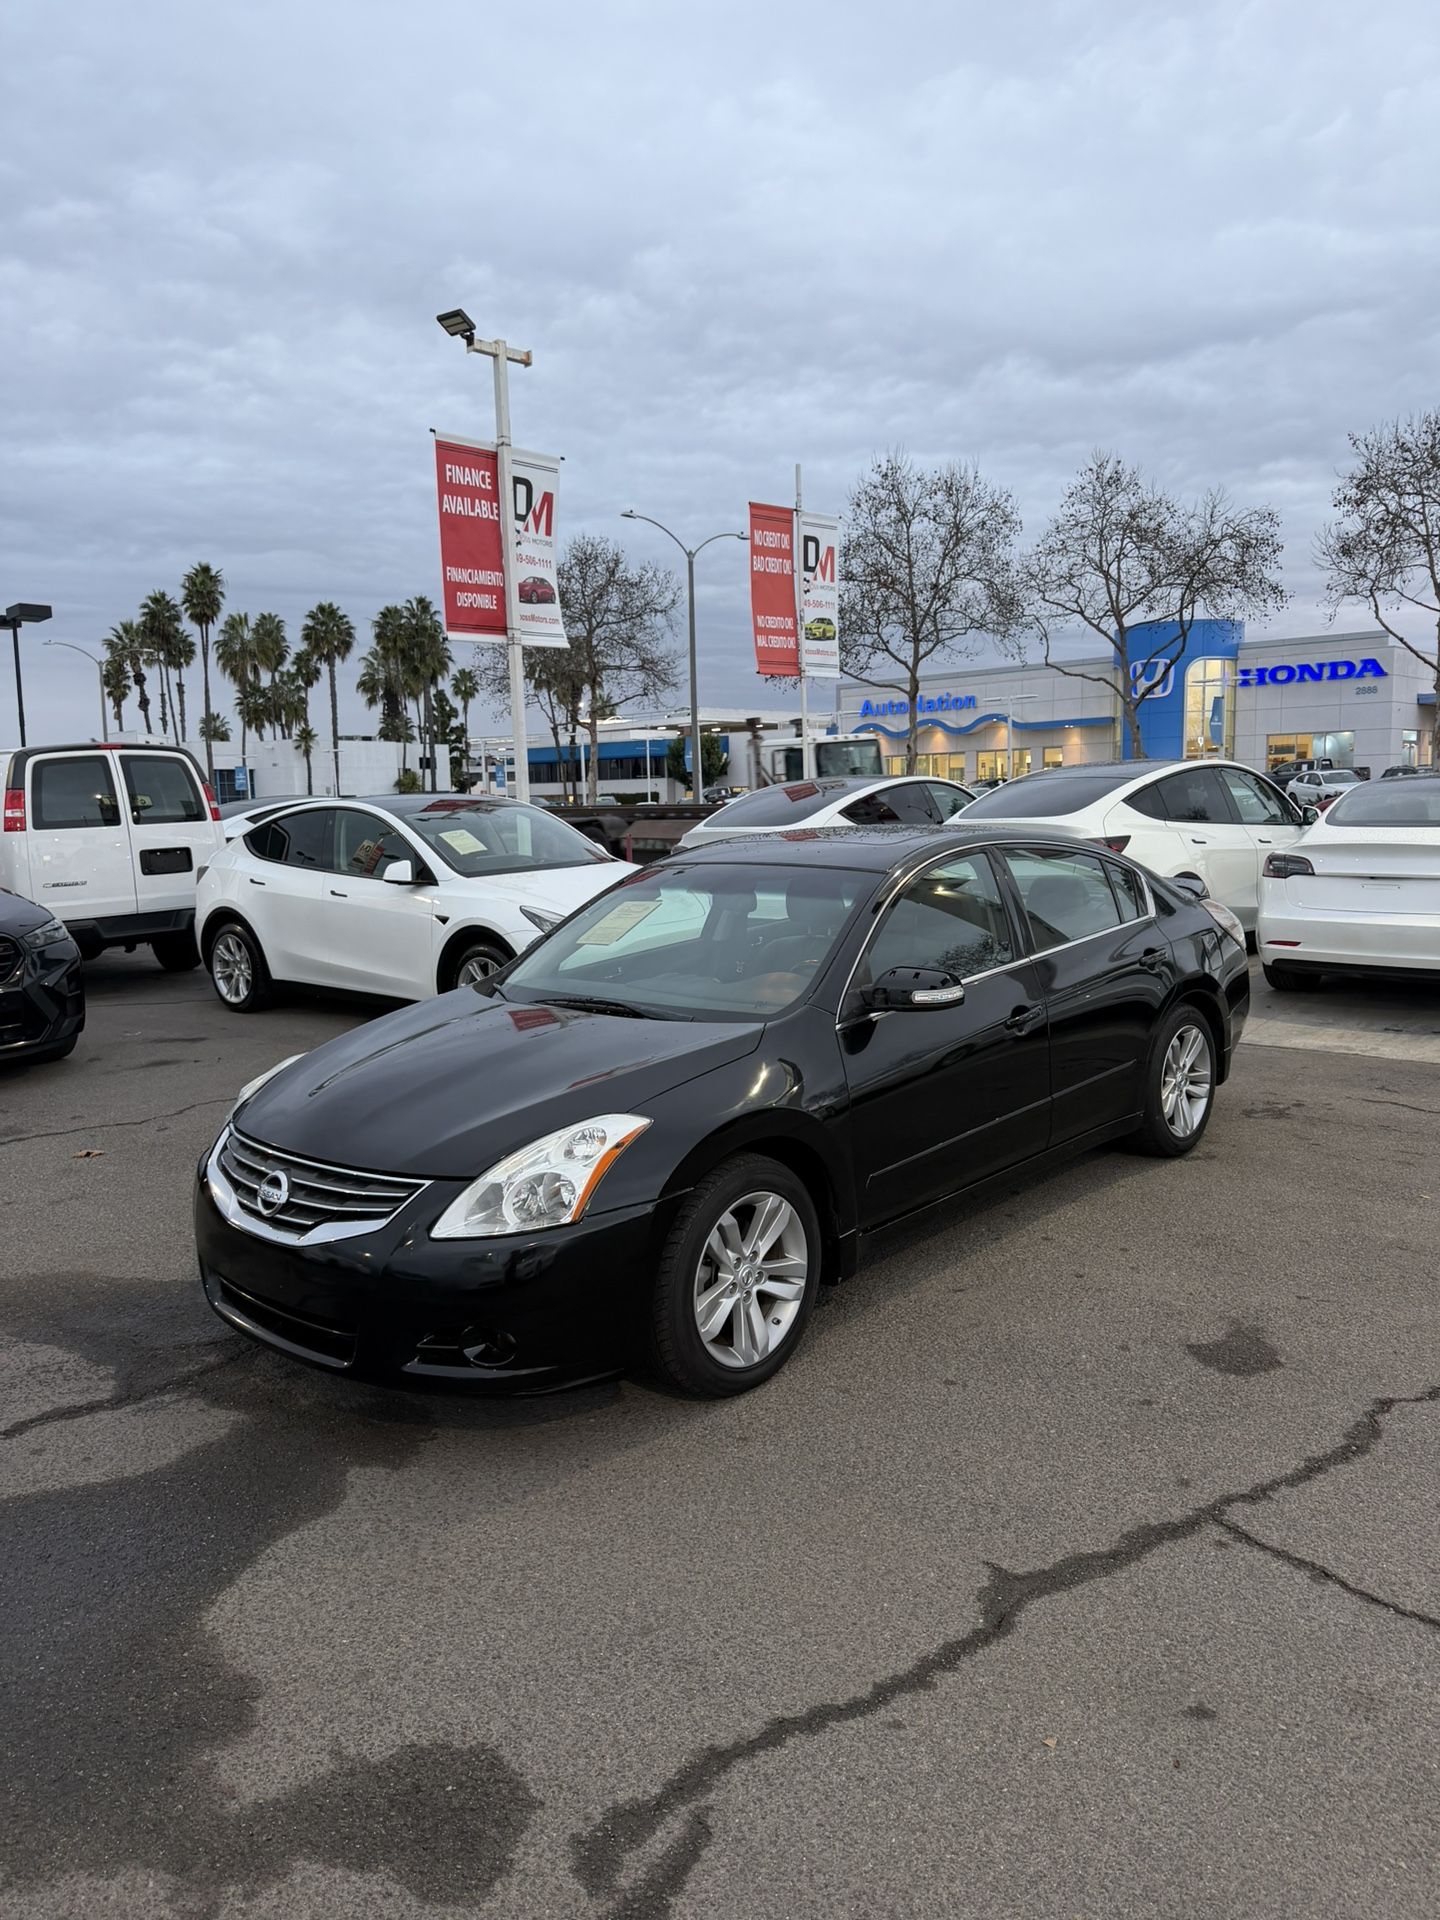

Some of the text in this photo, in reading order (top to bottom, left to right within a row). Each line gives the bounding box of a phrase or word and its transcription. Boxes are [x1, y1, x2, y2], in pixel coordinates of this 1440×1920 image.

[446, 464, 492, 489] FINANCE
[442, 494, 499, 521] AVAILABLE
[754, 529, 762, 546] NO
[763, 530, 780, 549] CREDIT
[753, 555, 764, 571] BAD
[765, 556, 782, 574] CREDIT
[803, 534, 835, 583] DM
[446, 566, 504, 587] FINANCIAMIENTO
[456, 591, 498, 610] DISPONIBLE
[1238, 658, 1388, 687] HONDA
[1355, 685, 1378, 695] 2888
